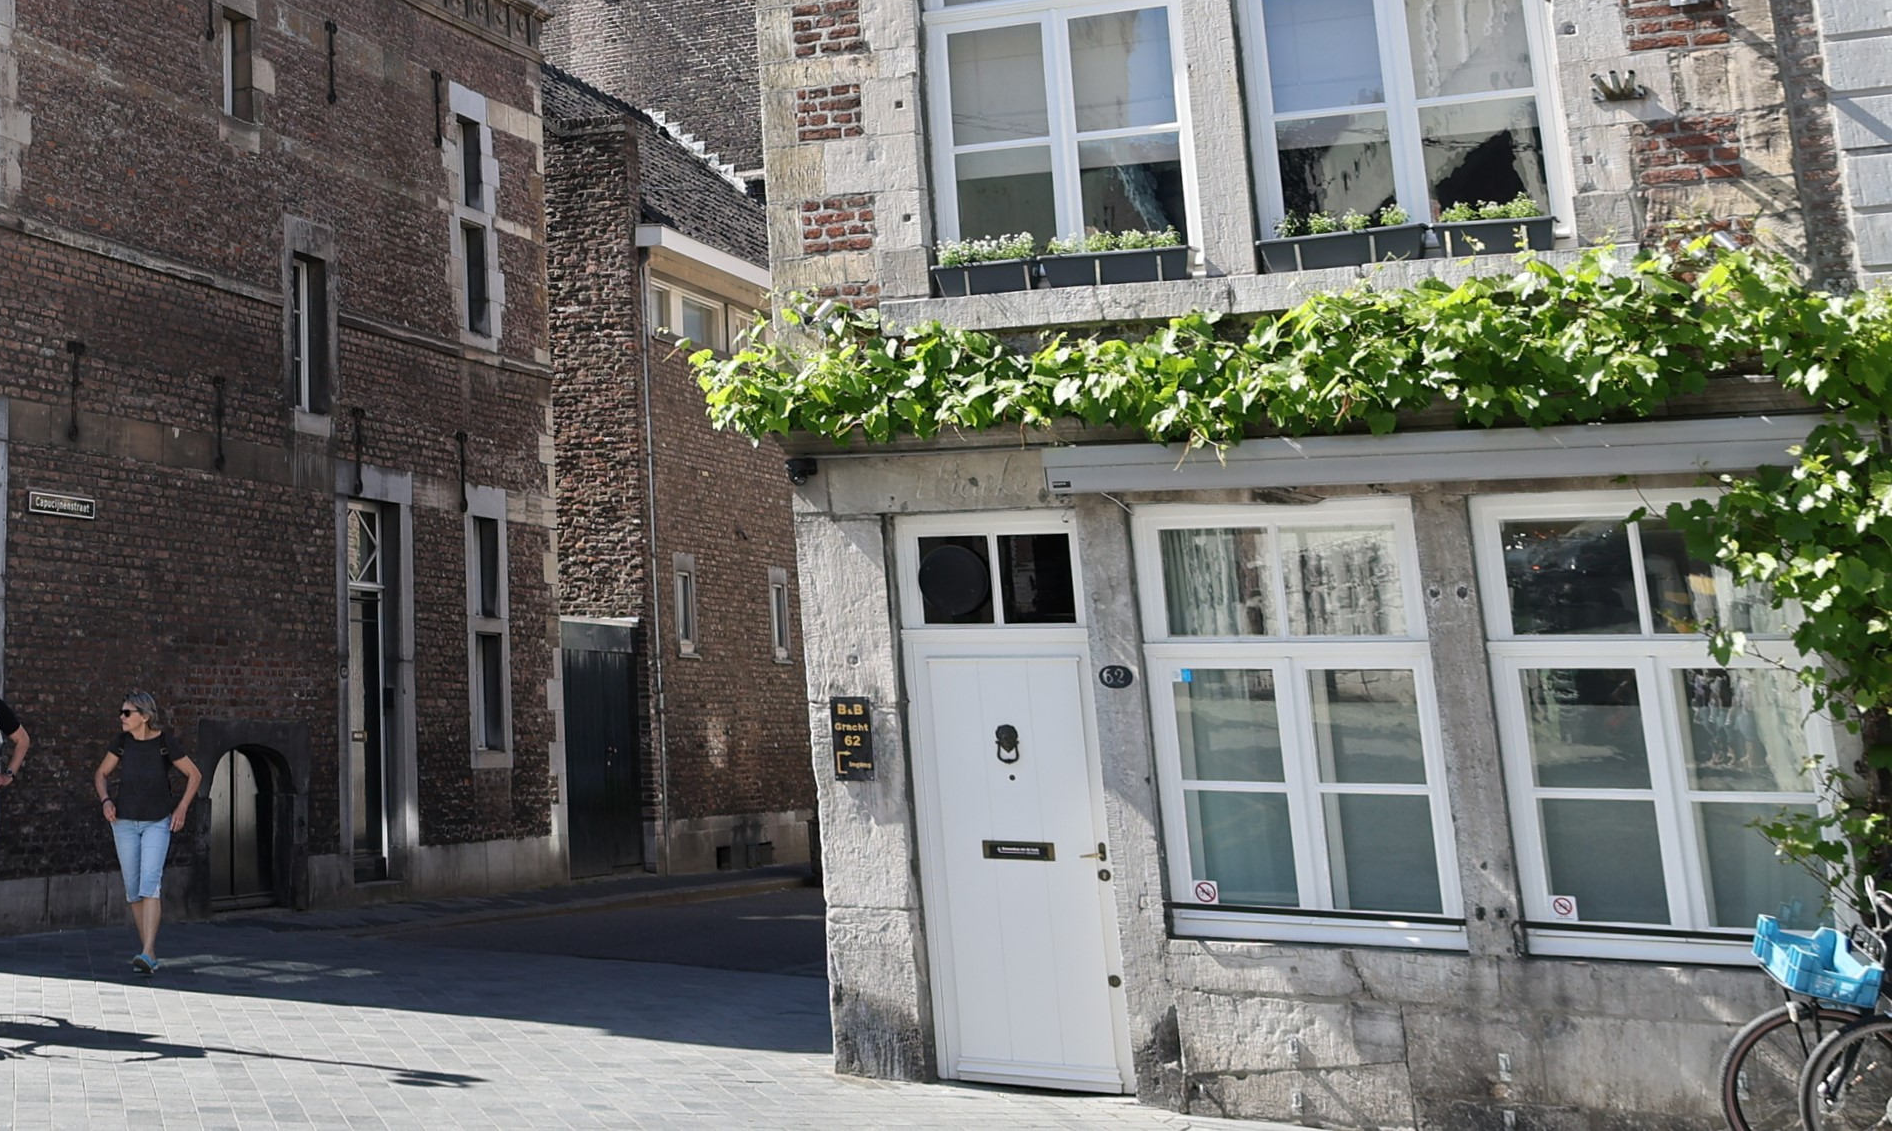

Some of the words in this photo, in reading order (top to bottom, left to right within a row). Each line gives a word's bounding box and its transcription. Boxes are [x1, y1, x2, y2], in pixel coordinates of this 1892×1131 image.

[35, 496, 90, 513] Capucijnenstraat
[1102, 668, 1124, 684] 62
[837, 703, 863, 715] B&B
[834, 722, 868, 732] Gracht
[844, 735, 861, 746] 62
